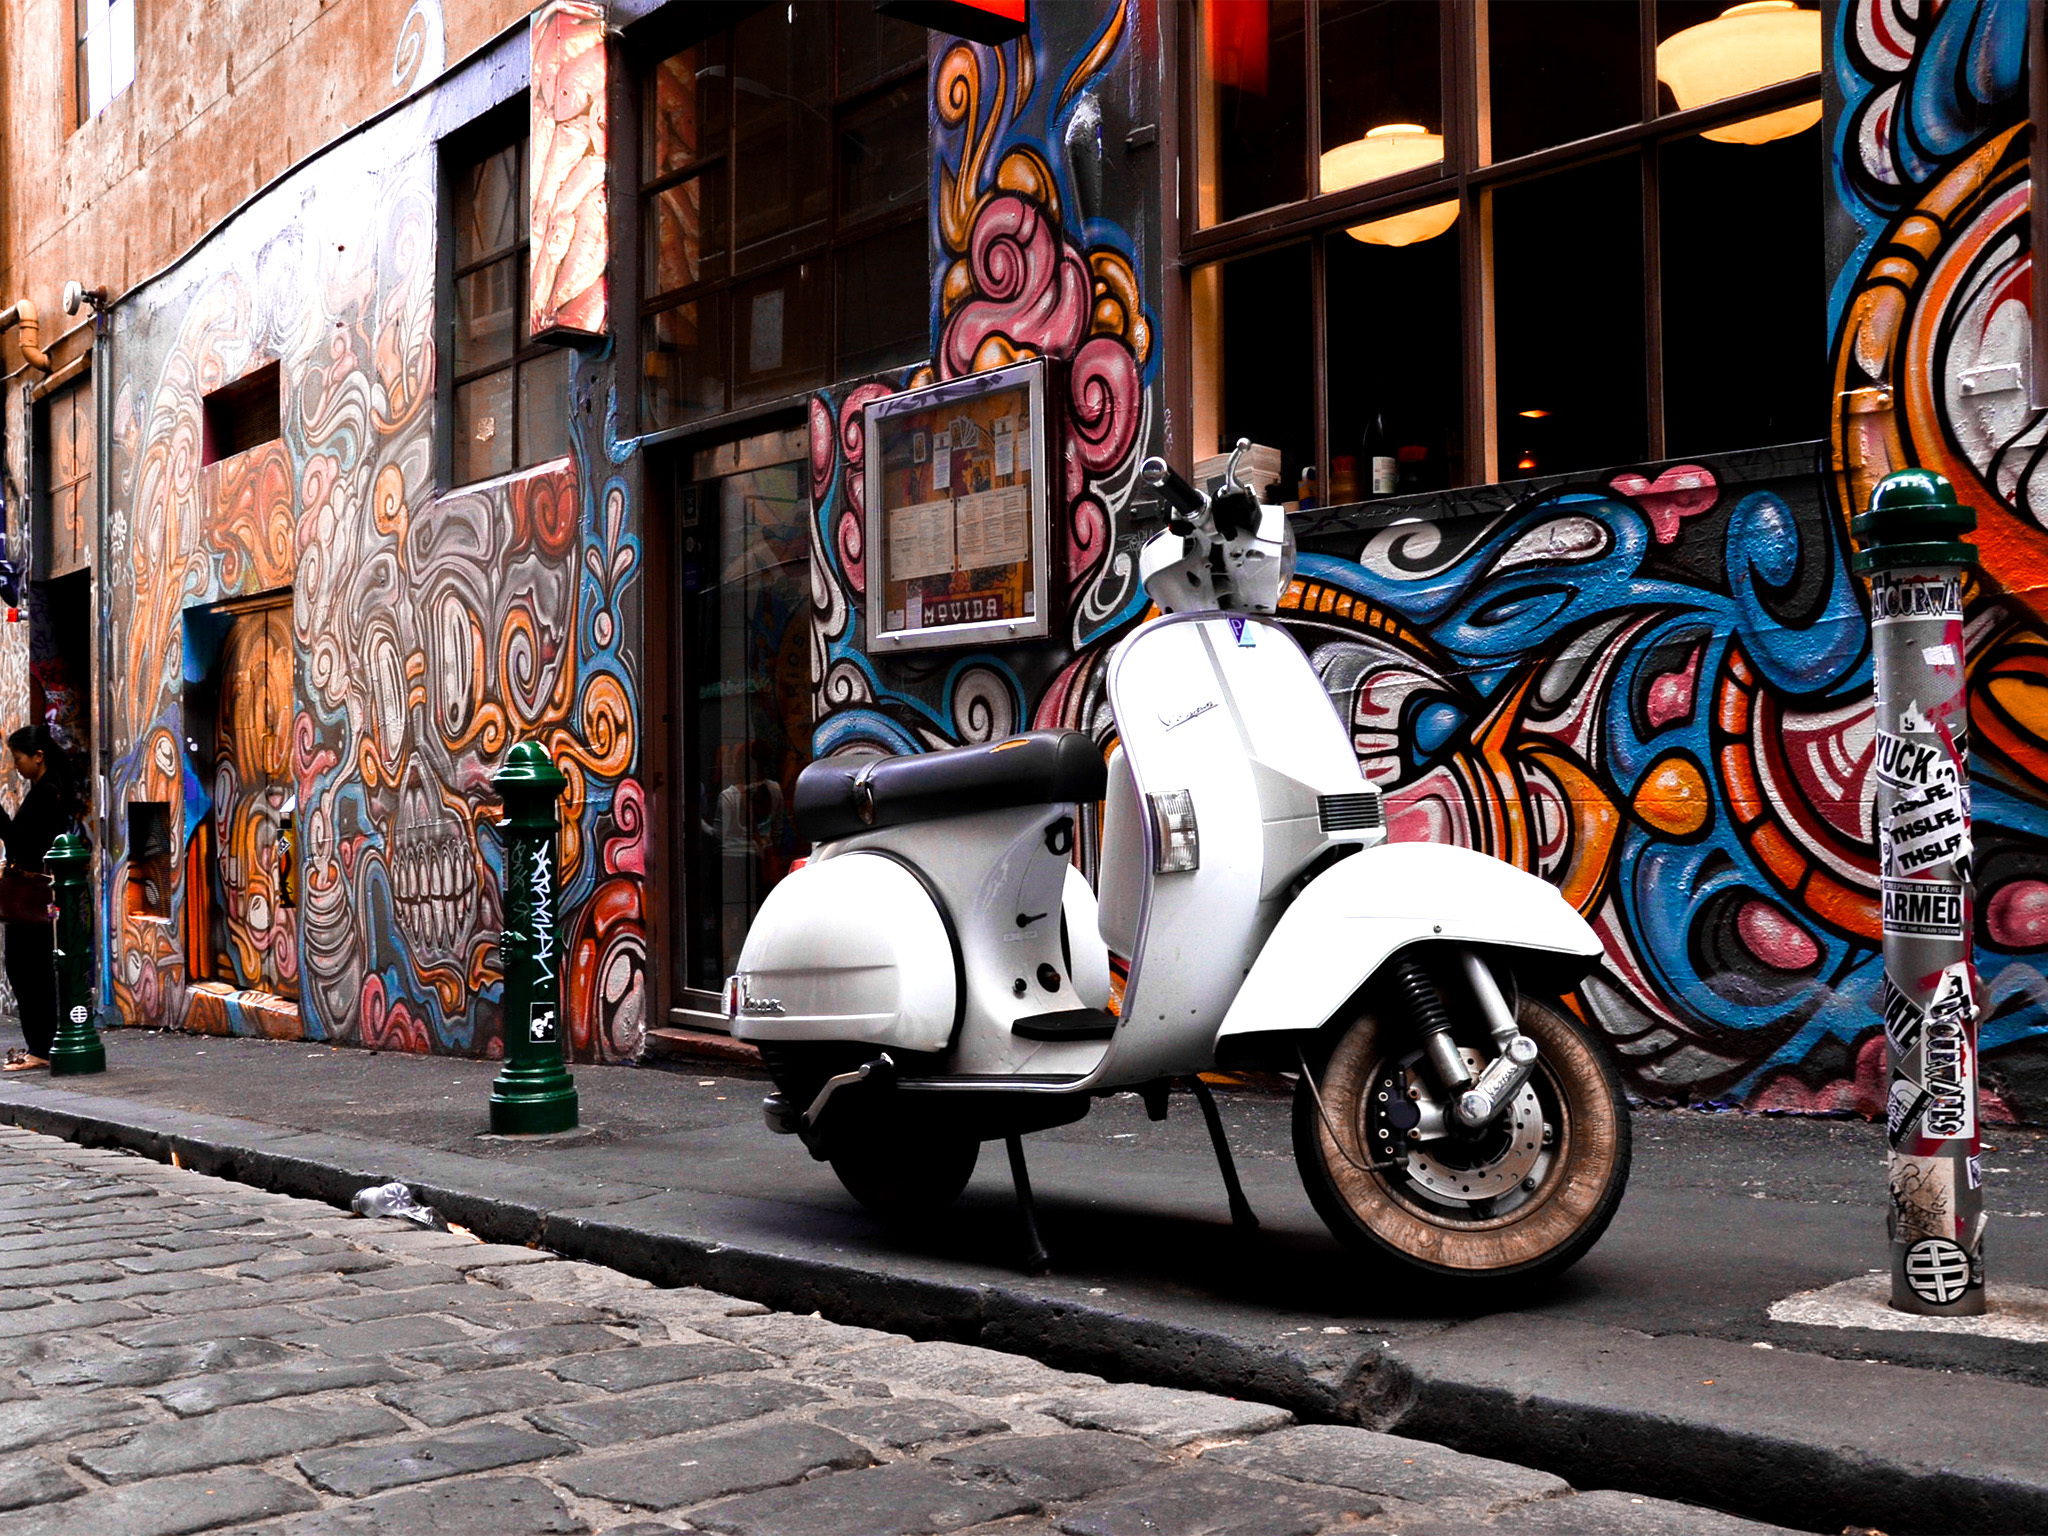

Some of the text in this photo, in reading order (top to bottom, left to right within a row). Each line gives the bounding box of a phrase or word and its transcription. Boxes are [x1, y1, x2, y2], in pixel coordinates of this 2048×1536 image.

[924, 598, 998, 624] MOVIDA
[1926, 884, 1940, 893] THE
[1884, 892, 1961, 925] ARMED
